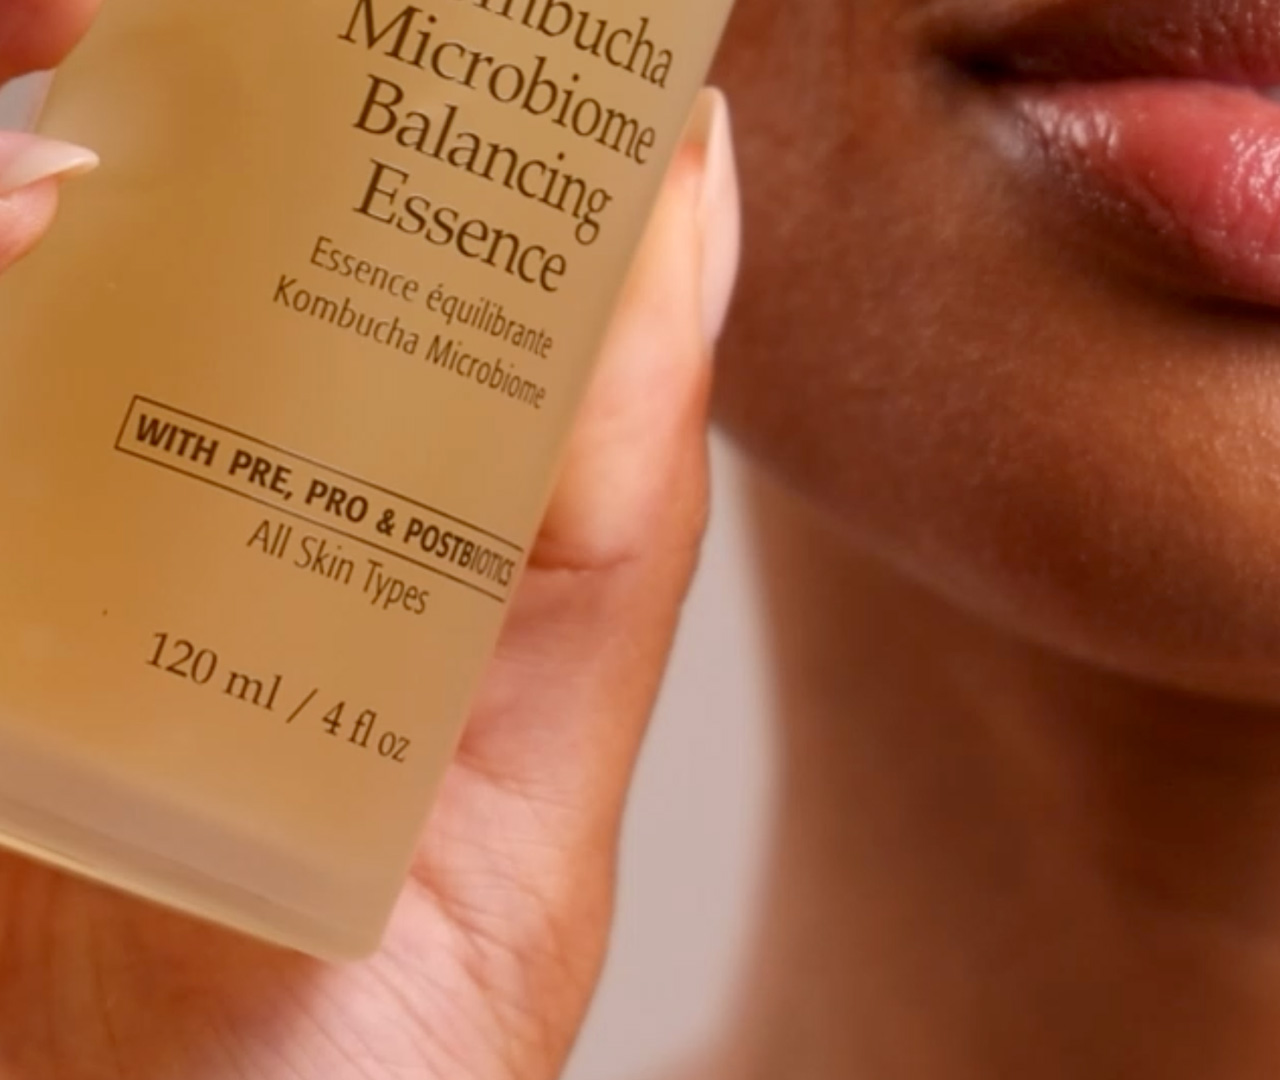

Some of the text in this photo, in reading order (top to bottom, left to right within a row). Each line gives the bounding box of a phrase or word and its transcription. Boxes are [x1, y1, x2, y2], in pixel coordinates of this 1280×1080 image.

[352, 73, 612, 246] Balancing
[352, 158, 567, 292] Essence
[272, 274, 546, 409] Kombucha Microbiome
[309, 235, 553, 359] Essence équilibrante
[135, 413, 516, 588] WITH PRE, PRO & POSTBIOTICS
[246, 519, 429, 616] All Skin Types
[145, 630, 218, 685] 120
[223, 665, 282, 711] ml
[321, 700, 346, 736] 4
[347, 709, 377, 747] fl
[377, 730, 411, 763] oz
